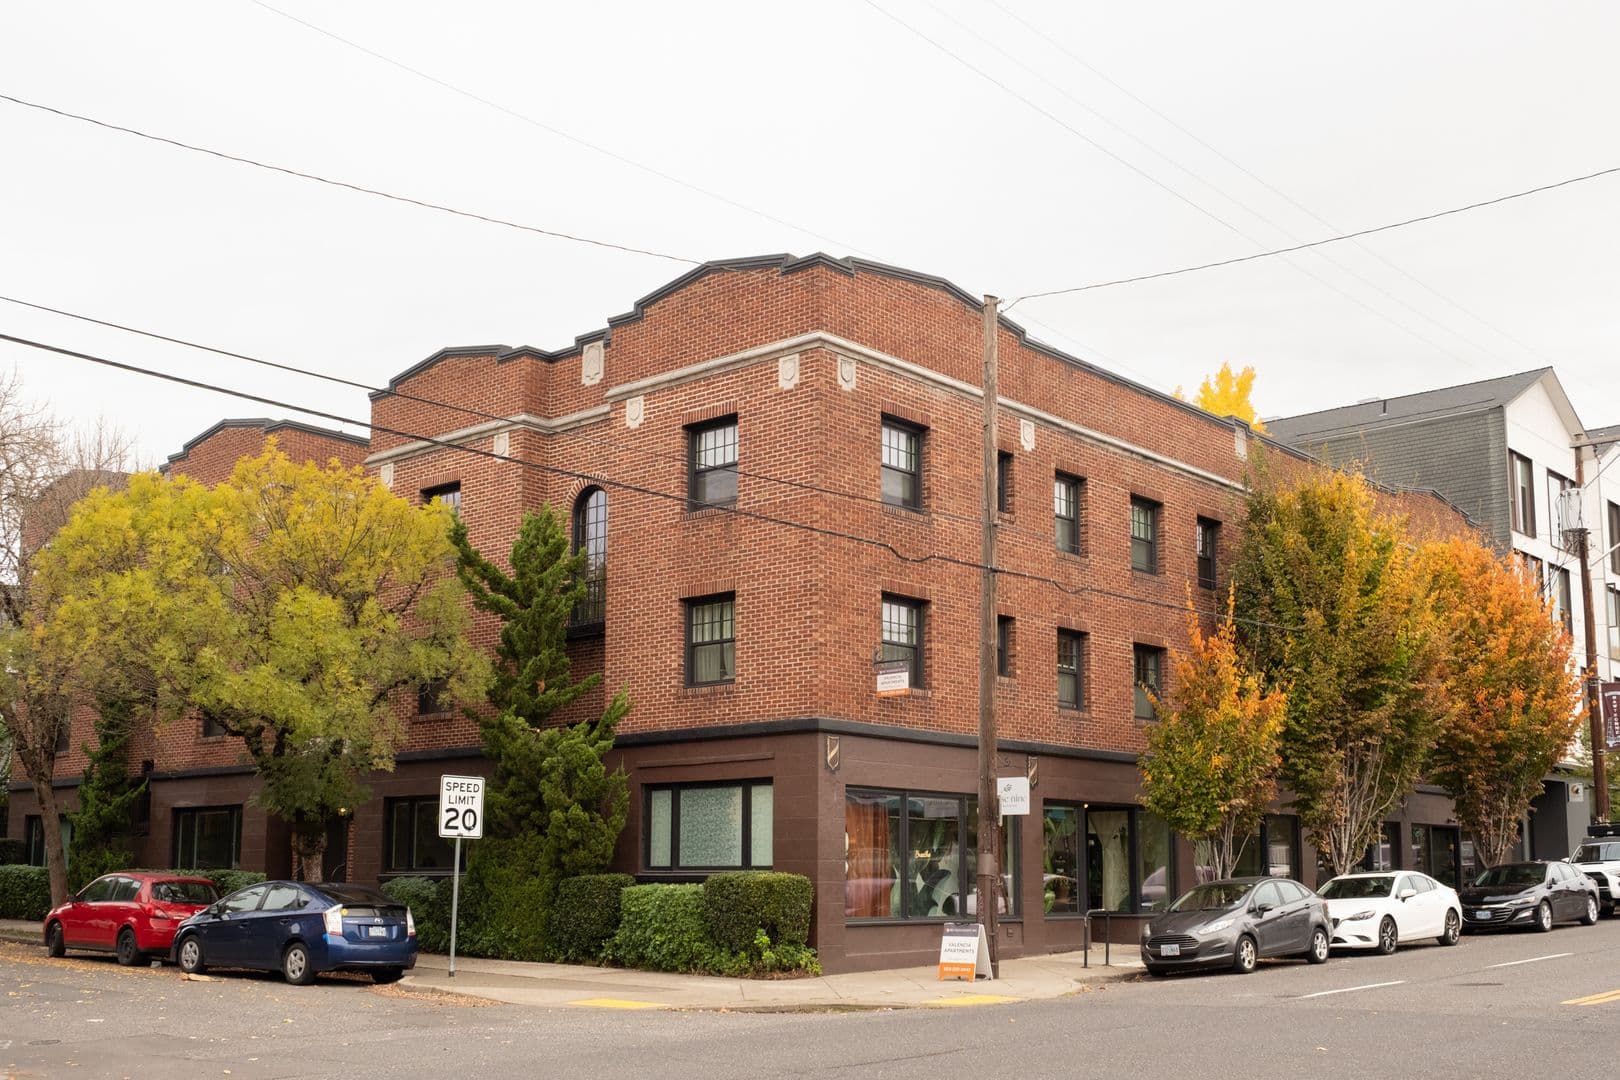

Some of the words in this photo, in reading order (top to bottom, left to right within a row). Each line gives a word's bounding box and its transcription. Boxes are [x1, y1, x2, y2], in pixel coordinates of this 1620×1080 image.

[445, 781, 480, 793] SPEED
[448, 795, 476, 805] LIMIT
[444, 807, 477, 832] 20
